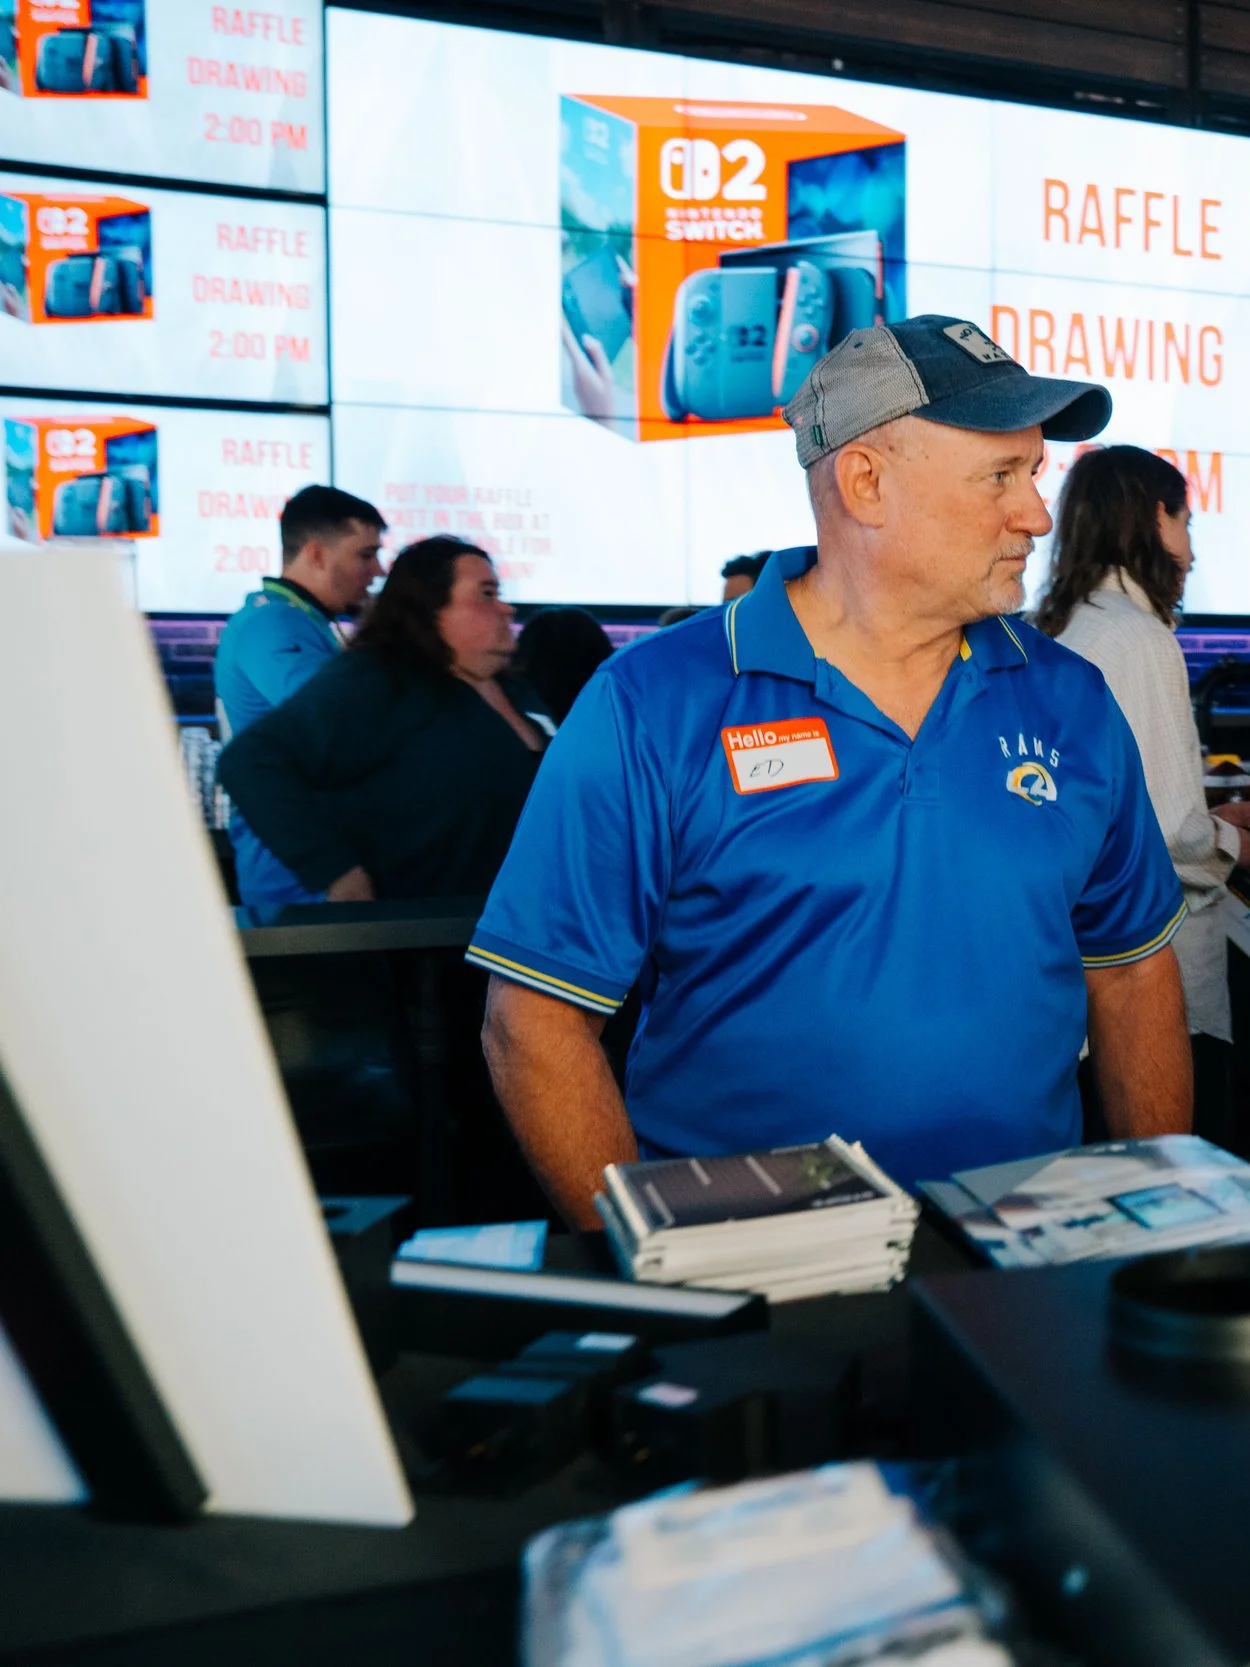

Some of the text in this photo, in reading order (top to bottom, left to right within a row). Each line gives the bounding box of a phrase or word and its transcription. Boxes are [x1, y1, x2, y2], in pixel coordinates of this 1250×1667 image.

[211, 5, 306, 46] RAFFLE
[186, 56, 307, 98] DRAWING
[203, 113, 308, 151] 2:00 PM
[665, 219, 766, 241] SWITCH
[1043, 177, 1223, 261] RAFFLE
[216, 223, 309, 258] RAFFLE
[192, 274, 310, 310] DRAWING
[208, 330, 310, 362] 2:00 PM
[991, 304, 1224, 388] DRAWING
[222, 437, 312, 470] RAFFLE
[213, 544, 270, 574] 2:00
[727, 728, 777, 750] Hello
[778, 734, 790, 743] my
[791, 731, 812, 741] name
[998, 732, 1060, 768] RAMS
[749, 758, 784, 778] ED
